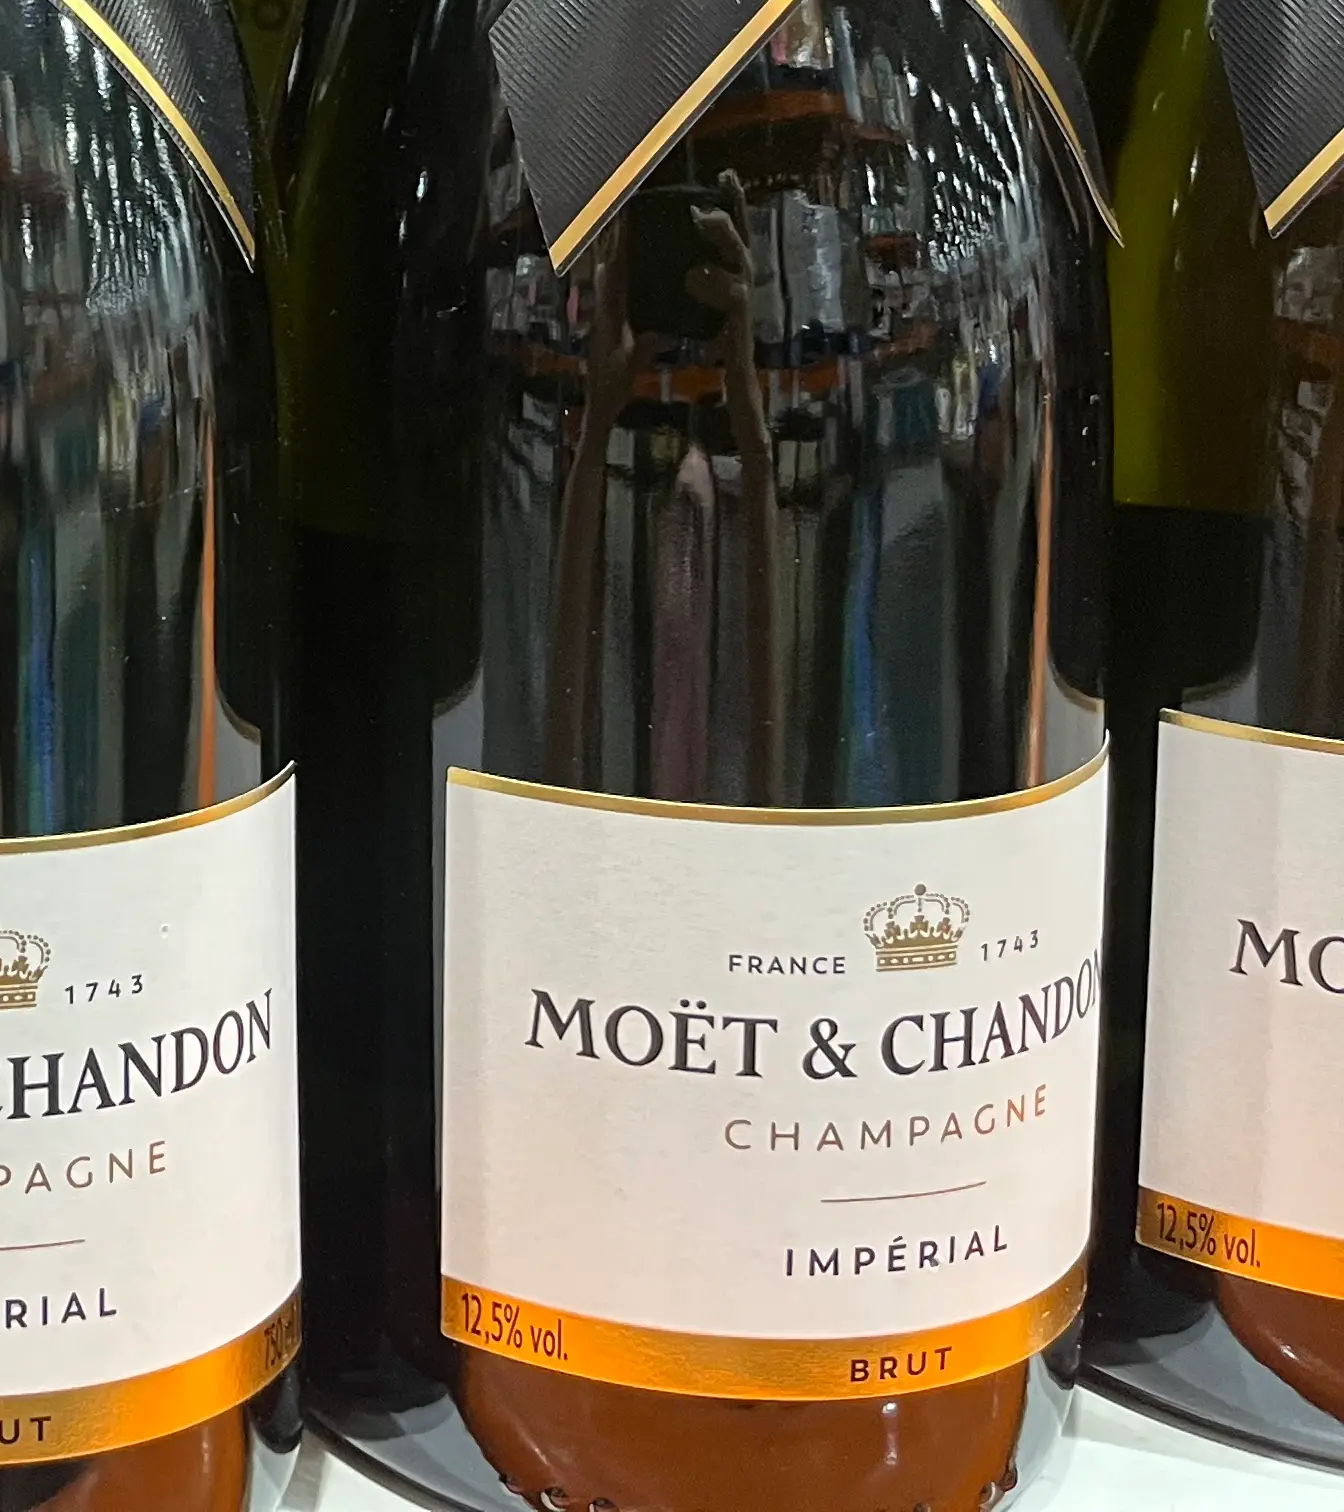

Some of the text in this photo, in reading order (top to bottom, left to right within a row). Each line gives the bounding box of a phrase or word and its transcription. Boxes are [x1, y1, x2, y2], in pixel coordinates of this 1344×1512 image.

[728, 928, 1040, 975] FRANCE 1743
[65, 974, 144, 1006] 1743
[524, 987, 778, 1079] MOËT
[802, 1016, 858, 1082] &
[724, 1083, 1048, 1152] CHAMPAGNE
[786, 1224, 1009, 1277] IMPÉRIAL
[1156, 1201, 1261, 1268] 12,5% vol.
[461, 1291, 569, 1362] 12,5% vol.
[850, 1346, 953, 1383] BRUT
